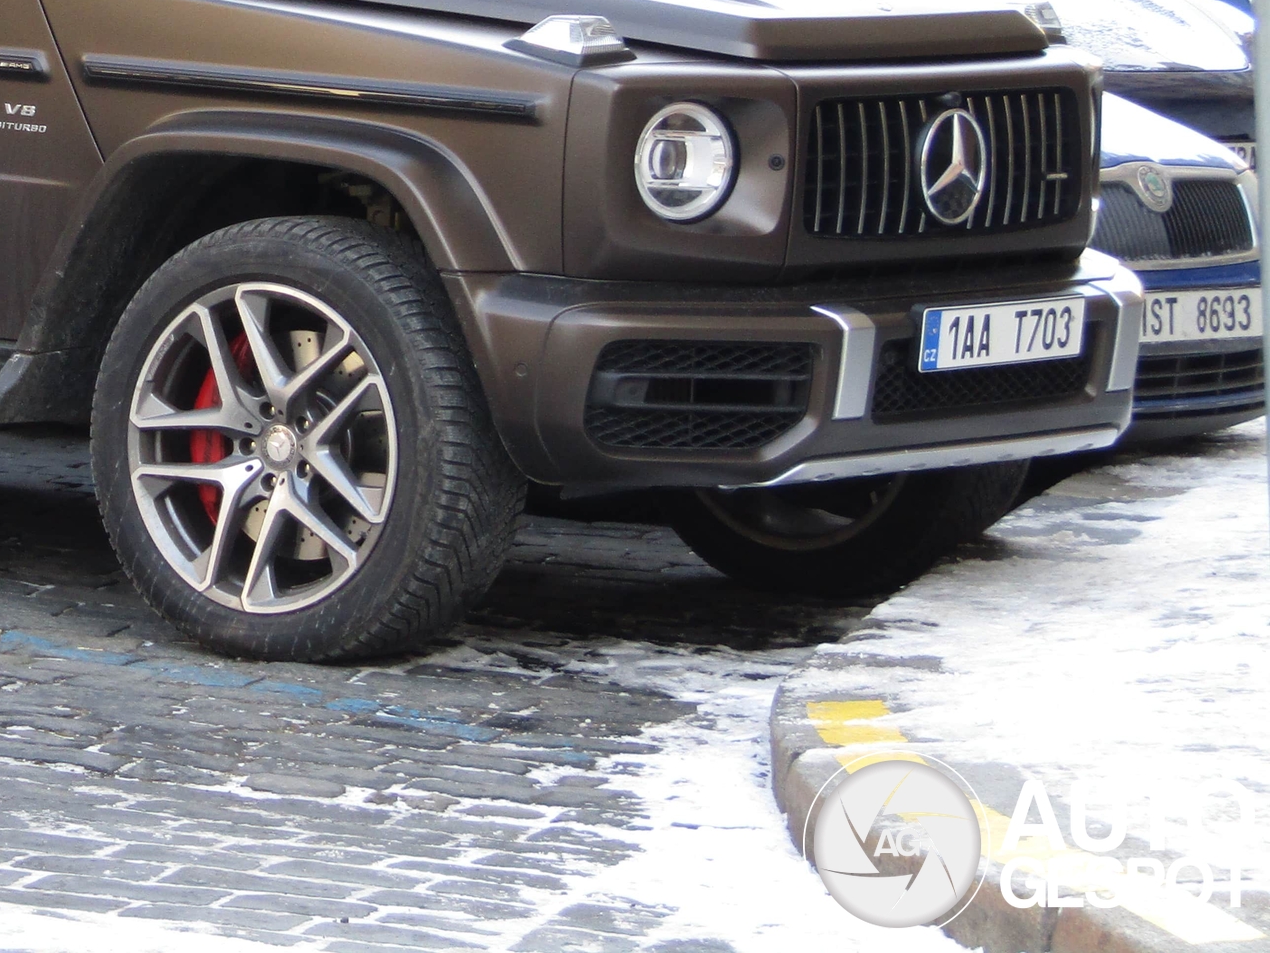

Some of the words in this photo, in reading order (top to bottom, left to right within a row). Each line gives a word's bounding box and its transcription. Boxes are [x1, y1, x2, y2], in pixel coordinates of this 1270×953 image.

[4, 103, 36, 117] V8
[1196, 294, 1251, 334] 8693
[948, 313, 991, 360] 1AA
[1014, 305, 1072, 354] T703
[923, 348, 937, 363] CZ
